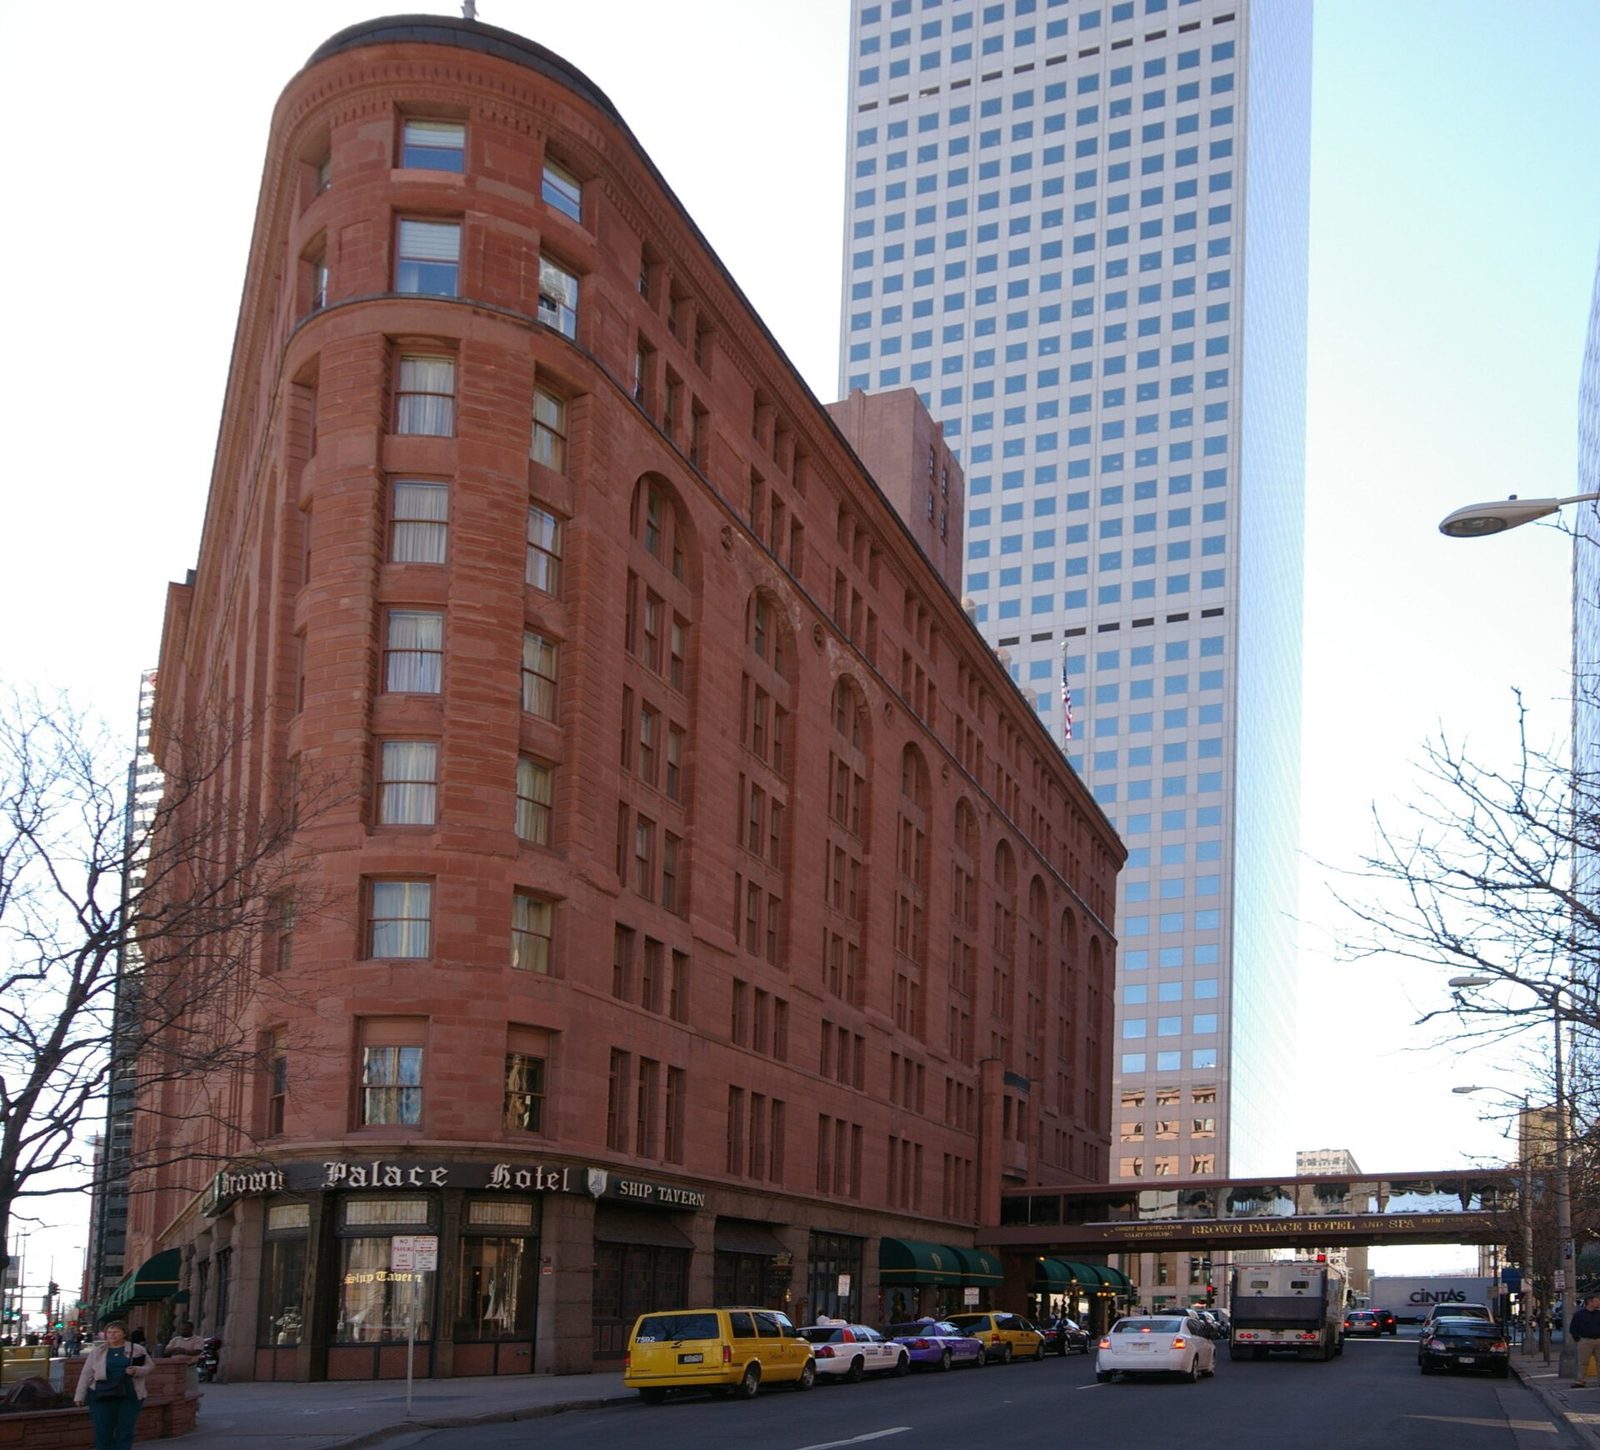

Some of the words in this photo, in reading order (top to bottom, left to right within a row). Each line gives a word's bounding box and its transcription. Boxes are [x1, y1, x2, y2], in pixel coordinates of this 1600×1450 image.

[221, 1170, 284, 1196] Brown
[321, 1160, 449, 1188] Palace
[485, 1163, 571, 1192] Hotel
[619, 1180, 653, 1198] SHIP
[658, 1186, 705, 1207] TAVERN
[1192, 1223, 1243, 1235] BROWN
[1249, 1221, 1302, 1233] PALACE
[1308, 1220, 1356, 1231] HOTEL
[1361, 1221, 1383, 1229] AND
[1388, 1219, 1416, 1229] SPA
[344, 1272, 374, 1284] Ship
